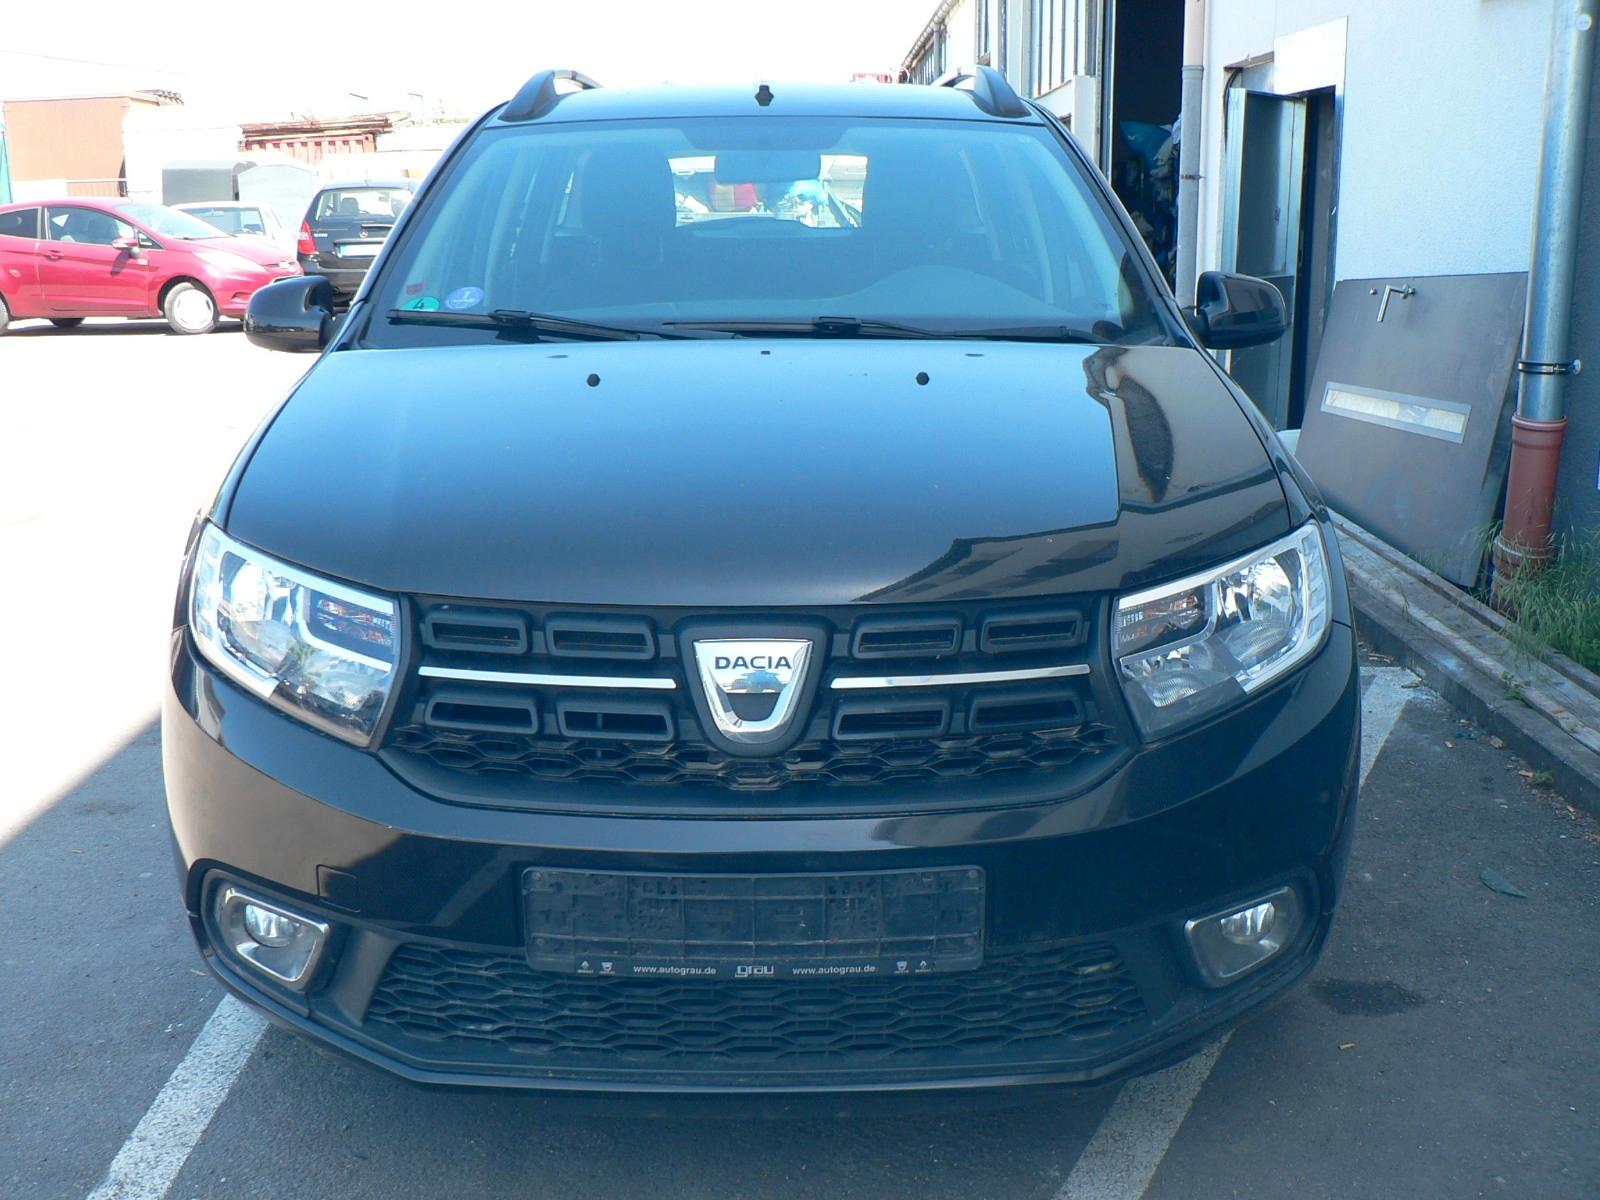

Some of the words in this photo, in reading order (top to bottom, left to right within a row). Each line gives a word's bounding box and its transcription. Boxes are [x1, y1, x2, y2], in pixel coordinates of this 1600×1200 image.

[413, 298, 425, 310] 4
[714, 655, 793, 670] DACIA
[633, 965, 717, 976] www.autograu.de
[734, 965, 775, 978] grau
[792, 964, 876, 975] www.autograu.de
